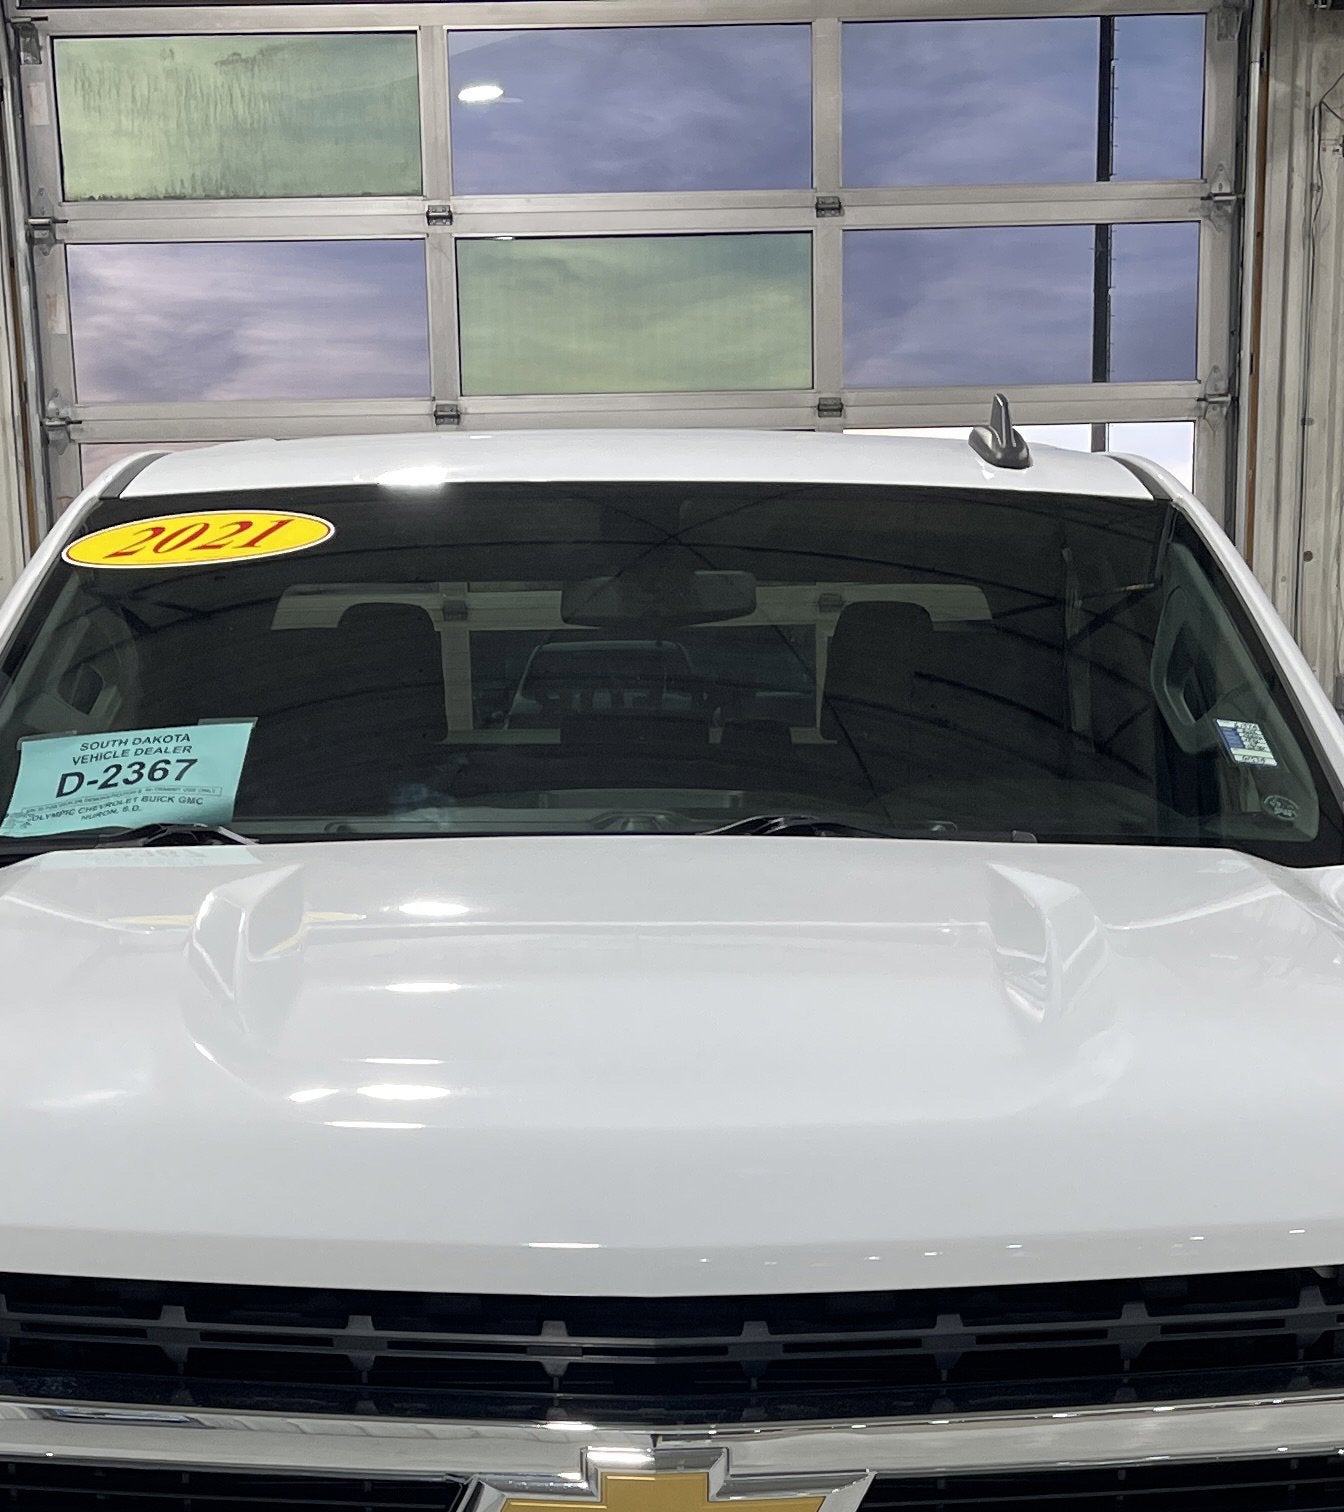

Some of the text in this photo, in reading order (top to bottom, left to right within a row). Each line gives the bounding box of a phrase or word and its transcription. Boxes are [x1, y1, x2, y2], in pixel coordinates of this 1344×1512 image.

[103, 518, 296, 559] 2021
[80, 733, 191, 751] SOUTH DAKOTA
[72, 745, 193, 765] VEHICLE DEALER
[56, 758, 198, 798] D-2367
[141, 795, 175, 804] BUICK
[178, 796, 204, 806] GMC
